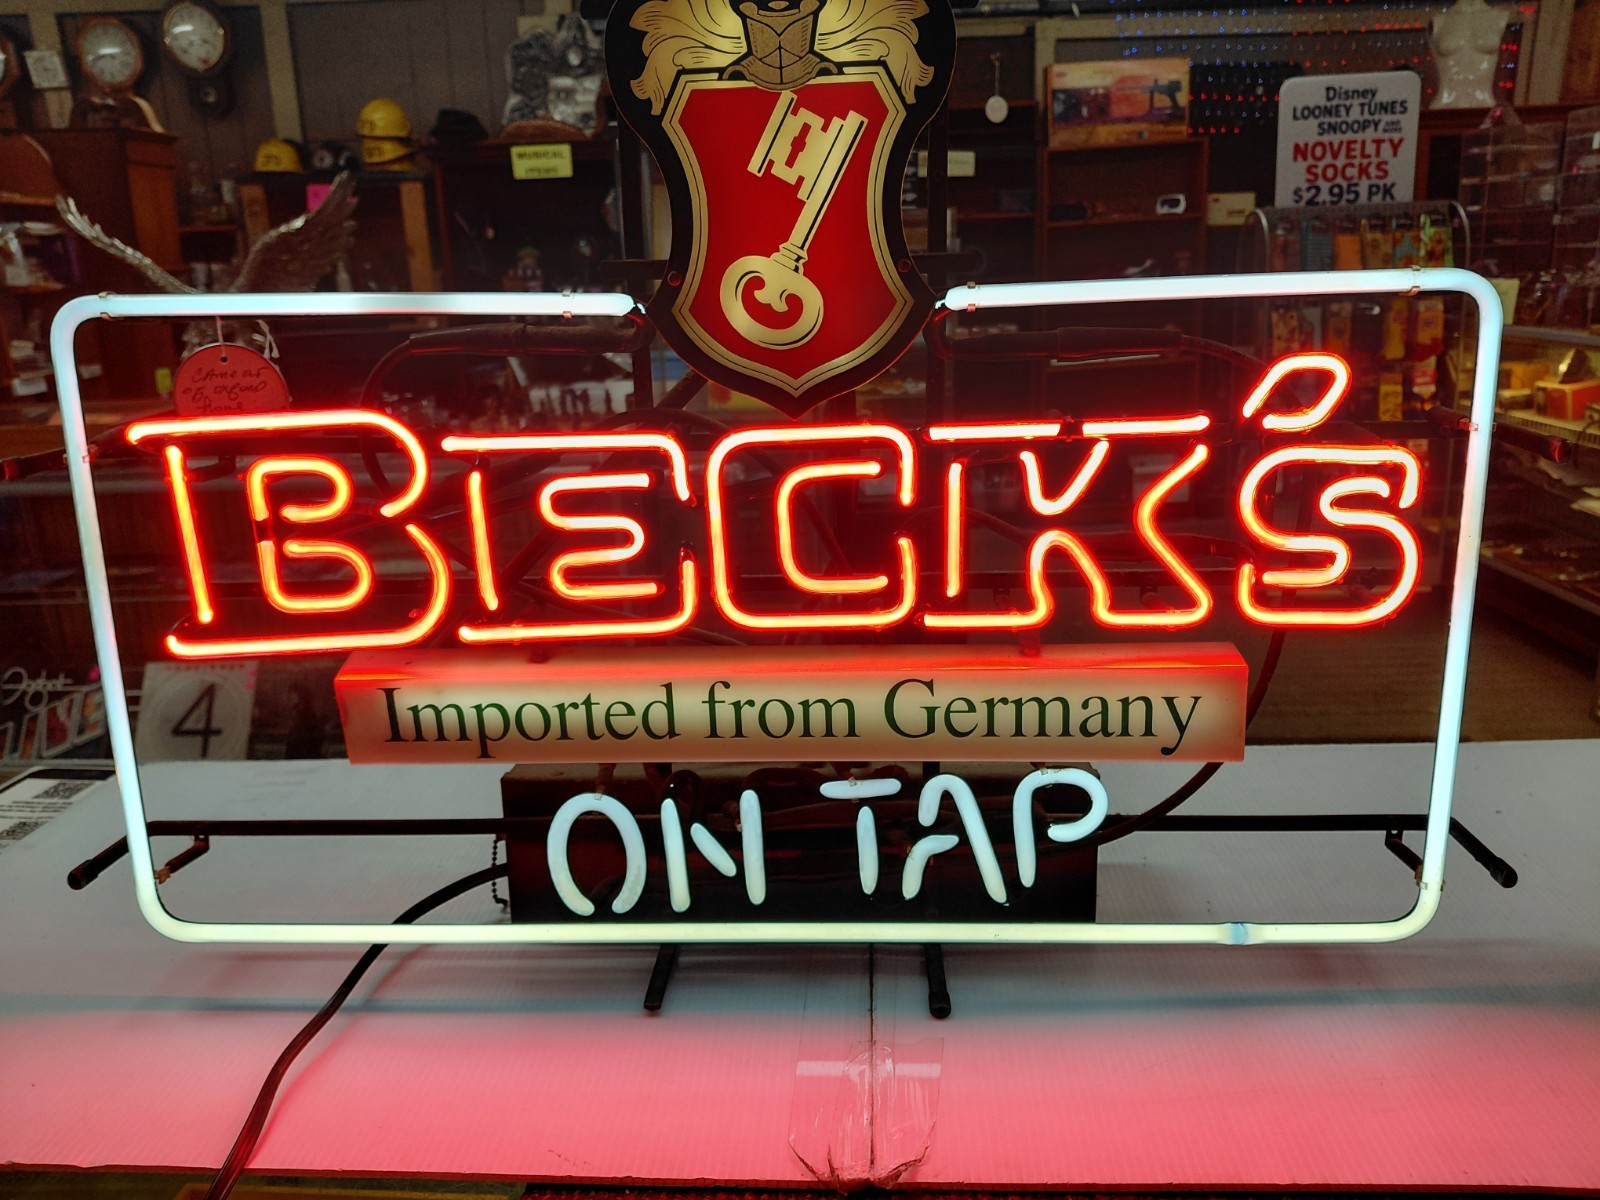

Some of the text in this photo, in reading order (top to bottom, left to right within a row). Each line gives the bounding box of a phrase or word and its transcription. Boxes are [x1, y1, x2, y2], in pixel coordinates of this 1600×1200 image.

[1326, 87, 1377, 101] Disney
[1292, 101, 1408, 120] LOONEY TUNES
[1318, 119, 1381, 136] SNOOPY
[1292, 138, 1404, 162] NOVELTY
[1305, 160, 1389, 184] SOCKS
[1293, 182, 1396, 206] $2.95 PK
[125, 352, 1423, 658] BECK'S
[171, 682, 223, 758] 4
[381, 678, 1203, 759] Imported from Germany
[546, 767, 1109, 917] ON TAP
